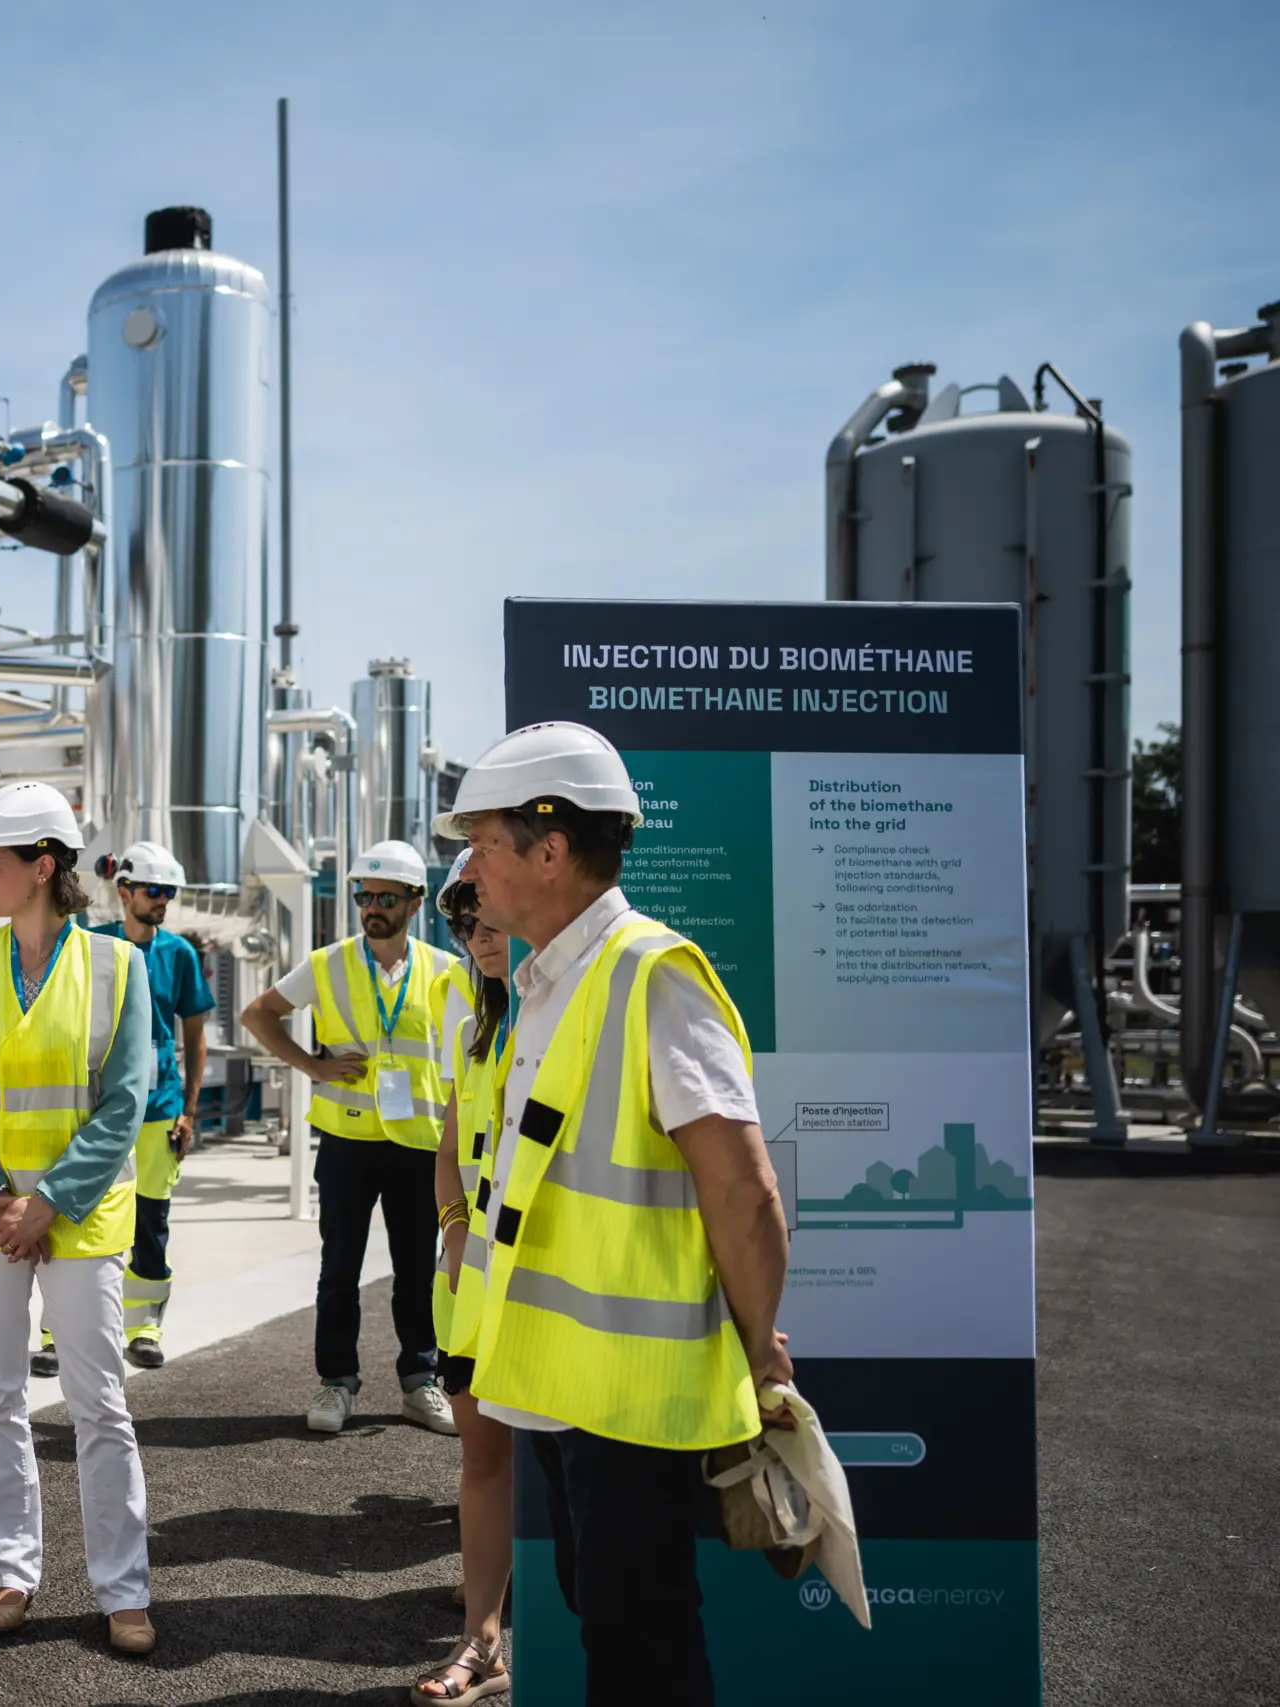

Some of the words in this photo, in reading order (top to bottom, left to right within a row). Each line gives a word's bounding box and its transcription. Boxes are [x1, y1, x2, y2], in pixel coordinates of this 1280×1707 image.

[563, 644, 719, 669] INJECTION
[728, 646, 770, 670] DU
[779, 643, 974, 673] BIOMÉTHANE
[588, 686, 783, 711] BIOMETHANE
[793, 688, 949, 714] INJECTION
[809, 780, 901, 793] Distribution
[809, 799, 825, 811] of
[830, 799, 856, 812] the
[860, 799, 953, 812] biomethane
[638, 818, 673, 829] seau
[809, 817, 840, 830] into
[844, 817, 871, 830] the
[875, 817, 906, 833] grid
[633, 846, 727, 856] conditionnement,
[834, 844, 896, 855] Compliance
[898, 844, 931, 855] check
[635, 858, 649, 867] de
[651, 858, 710, 868] conformité
[835, 857, 846, 867] of
[848, 857, 912, 867] biomethane
[915, 858, 938, 868] with
[940, 858, 961, 869] grid
[620, 871, 667, 880] méthane
[692, 873, 731, 881] normes
[835, 871, 881, 882] injection
[884, 871, 940, 881] standards,
[646, 884, 682, 893] réseau
[835, 883, 884, 894] following
[886, 884, 954, 894] conditioning
[651, 904, 666, 913] du
[668, 905, 687, 915] gaz
[835, 902, 855, 912] Gas
[857, 902, 918, 912] odorization
[671, 917, 680, 926] la
[682, 917, 735, 926] détection
[835, 916, 847, 925] to
[850, 915, 898, 925] facilitate
[900, 916, 919, 925] the
[921, 916, 973, 925] detection
[836, 928, 847, 938] of
[850, 929, 898, 940] potential
[901, 929, 928, 938] leaks
[885, 948, 896, 957] of
[899, 948, 962, 958] biomethane
[836, 961, 857, 970] into
[860, 961, 878, 970] the
[881, 961, 942, 970] distribution
[945, 961, 992, 972] network,
[836, 974, 889, 985] supplying
[892, 975, 950, 983] consumers
[802, 1106, 830, 1116] Poste
[847, 1118, 881, 1127] station
